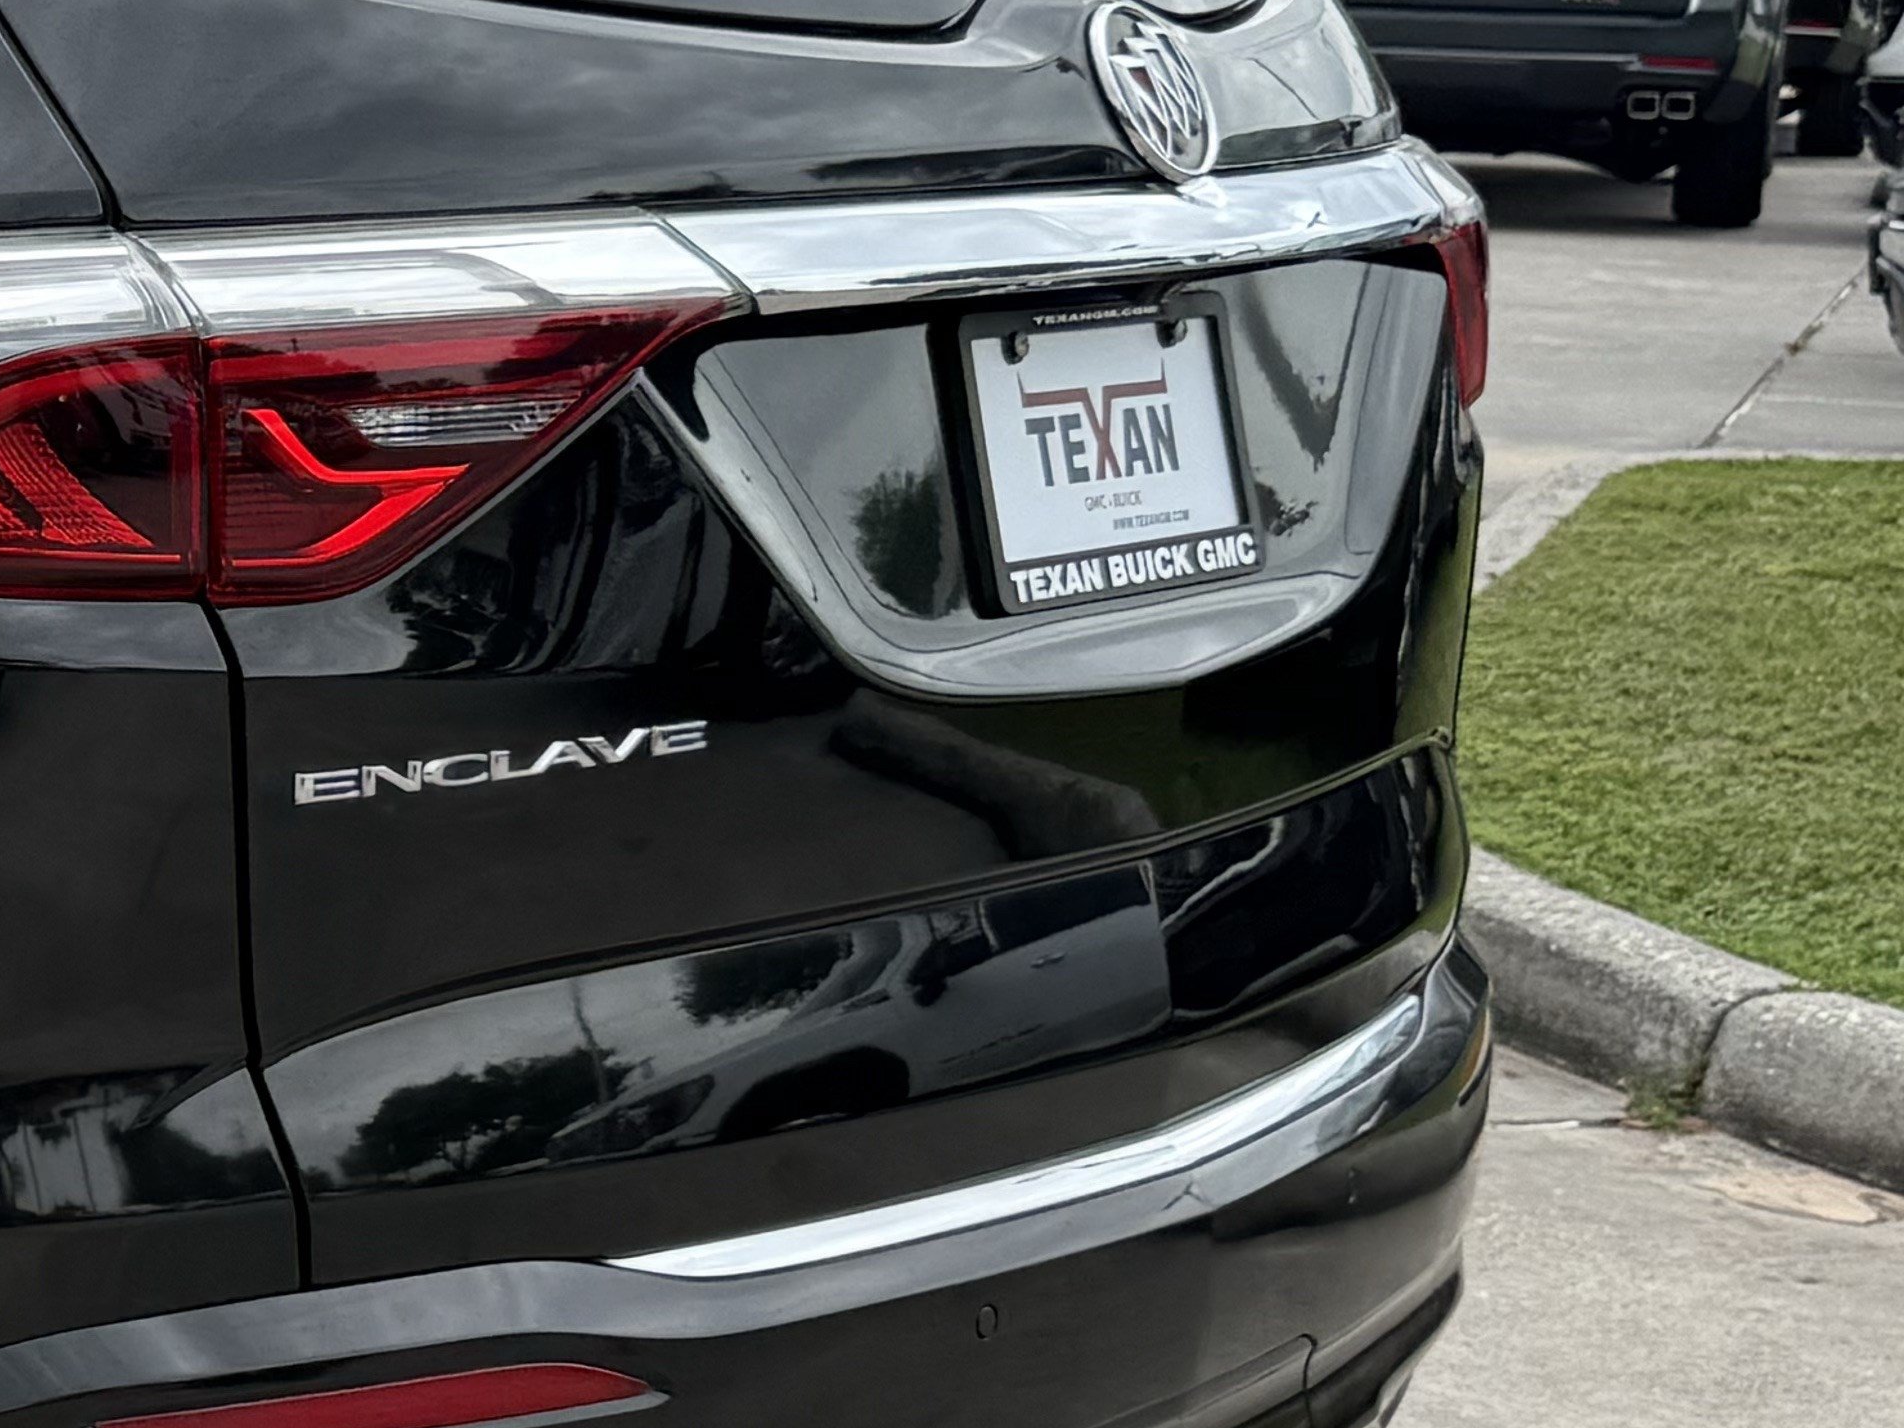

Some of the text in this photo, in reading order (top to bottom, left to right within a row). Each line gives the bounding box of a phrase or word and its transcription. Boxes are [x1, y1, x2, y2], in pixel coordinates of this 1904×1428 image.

[1018, 380, 1180, 487] TEXAN
[1010, 532, 1258, 604] TEXAN BUICK GMC
[294, 720, 708, 805] ENCLAVE
